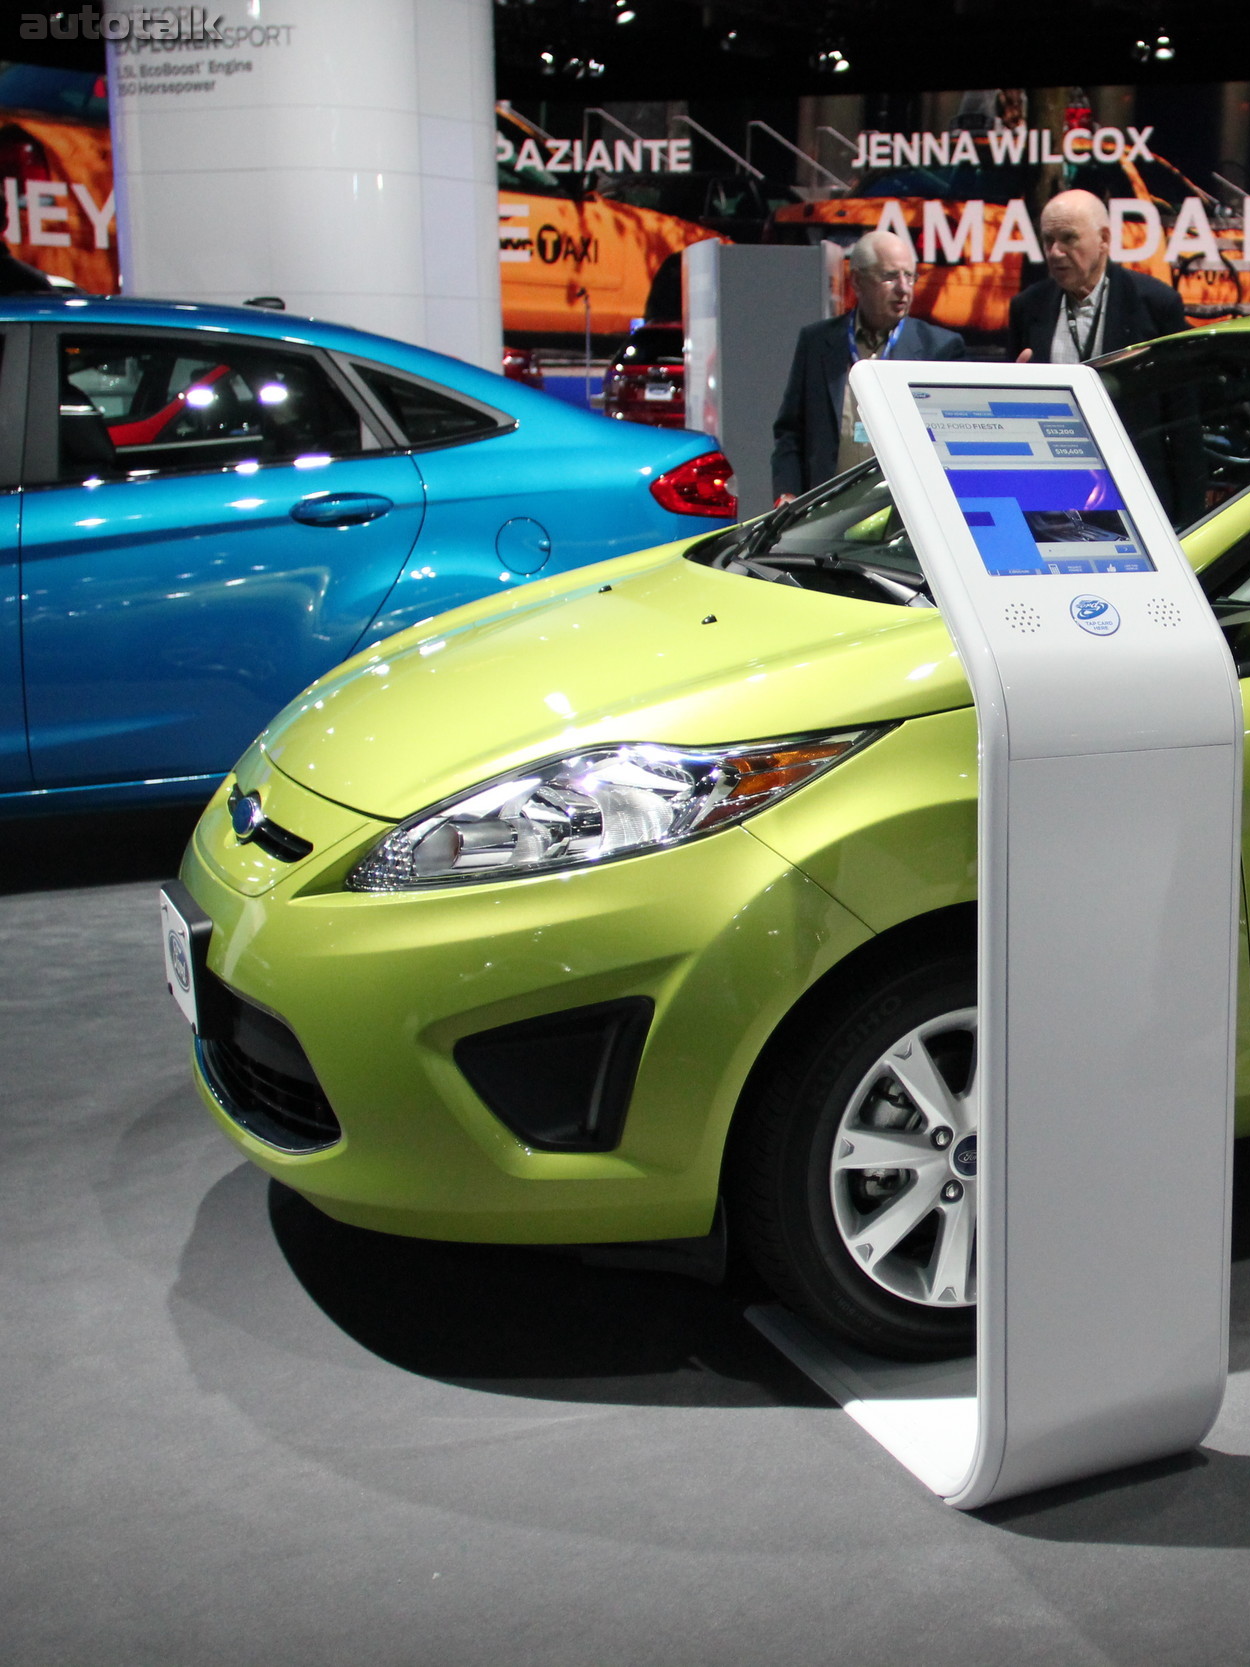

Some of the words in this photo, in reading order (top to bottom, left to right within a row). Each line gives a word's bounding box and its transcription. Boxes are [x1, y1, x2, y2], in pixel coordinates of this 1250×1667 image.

[222, 24, 296, 49] SPORT
[208, 59, 253, 76] Engine
[139, 80, 217, 95] Horsepower
[851, 131, 981, 168] JENNA
[987, 126, 1155, 166] WILCOX
[872, 197, 1223, 263] AMADA
[926, 423, 946, 431] 2012
[947, 423, 973, 431] FORD
[973, 423, 1005, 431] FIESTA
